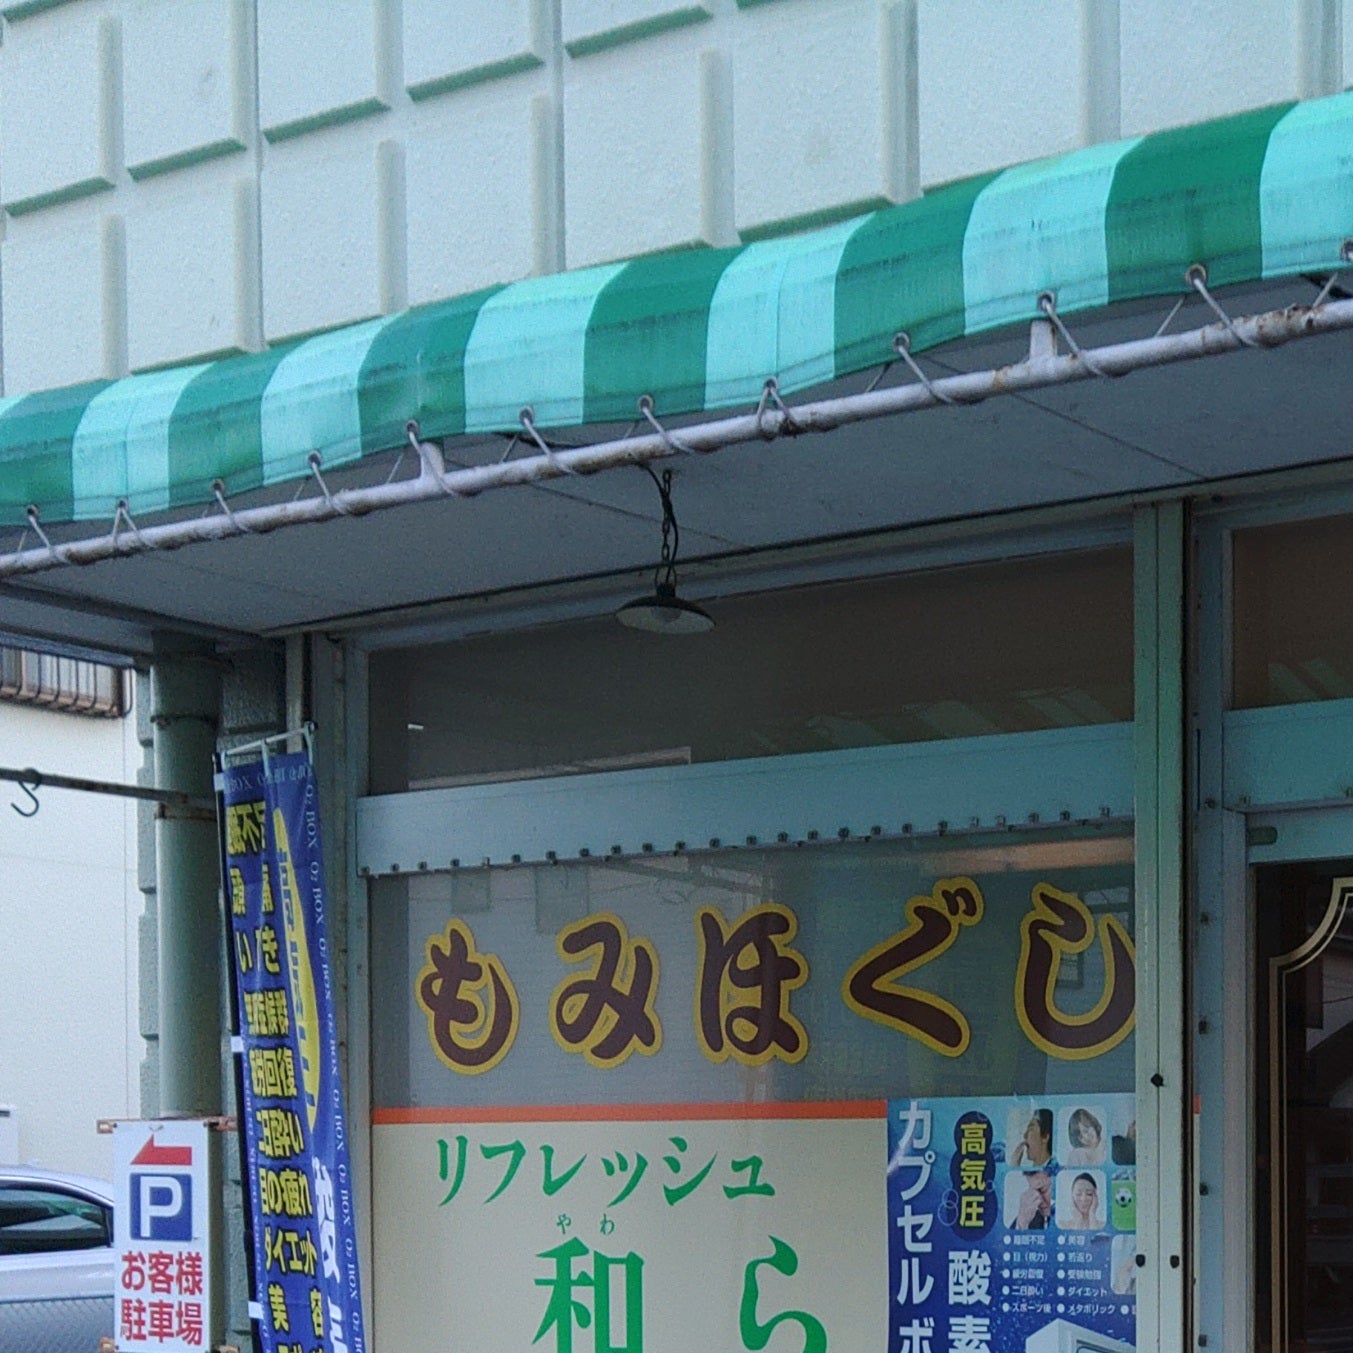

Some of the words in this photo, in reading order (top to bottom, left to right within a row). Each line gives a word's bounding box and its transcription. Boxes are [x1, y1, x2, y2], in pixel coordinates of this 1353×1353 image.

[415, 876, 1136, 1074] もみほぐし
[260, 1168, 312, 1215] 目の疲れ
[437, 1135, 776, 1208] リフレッシュ
[959, 1122, 988, 1228] 高気圧
[140, 1176, 182, 1237] P
[556, 1212, 616, 1236] やわ
[122, 1251, 203, 1295] お客様
[121, 1298, 202, 1346] 駐車場
